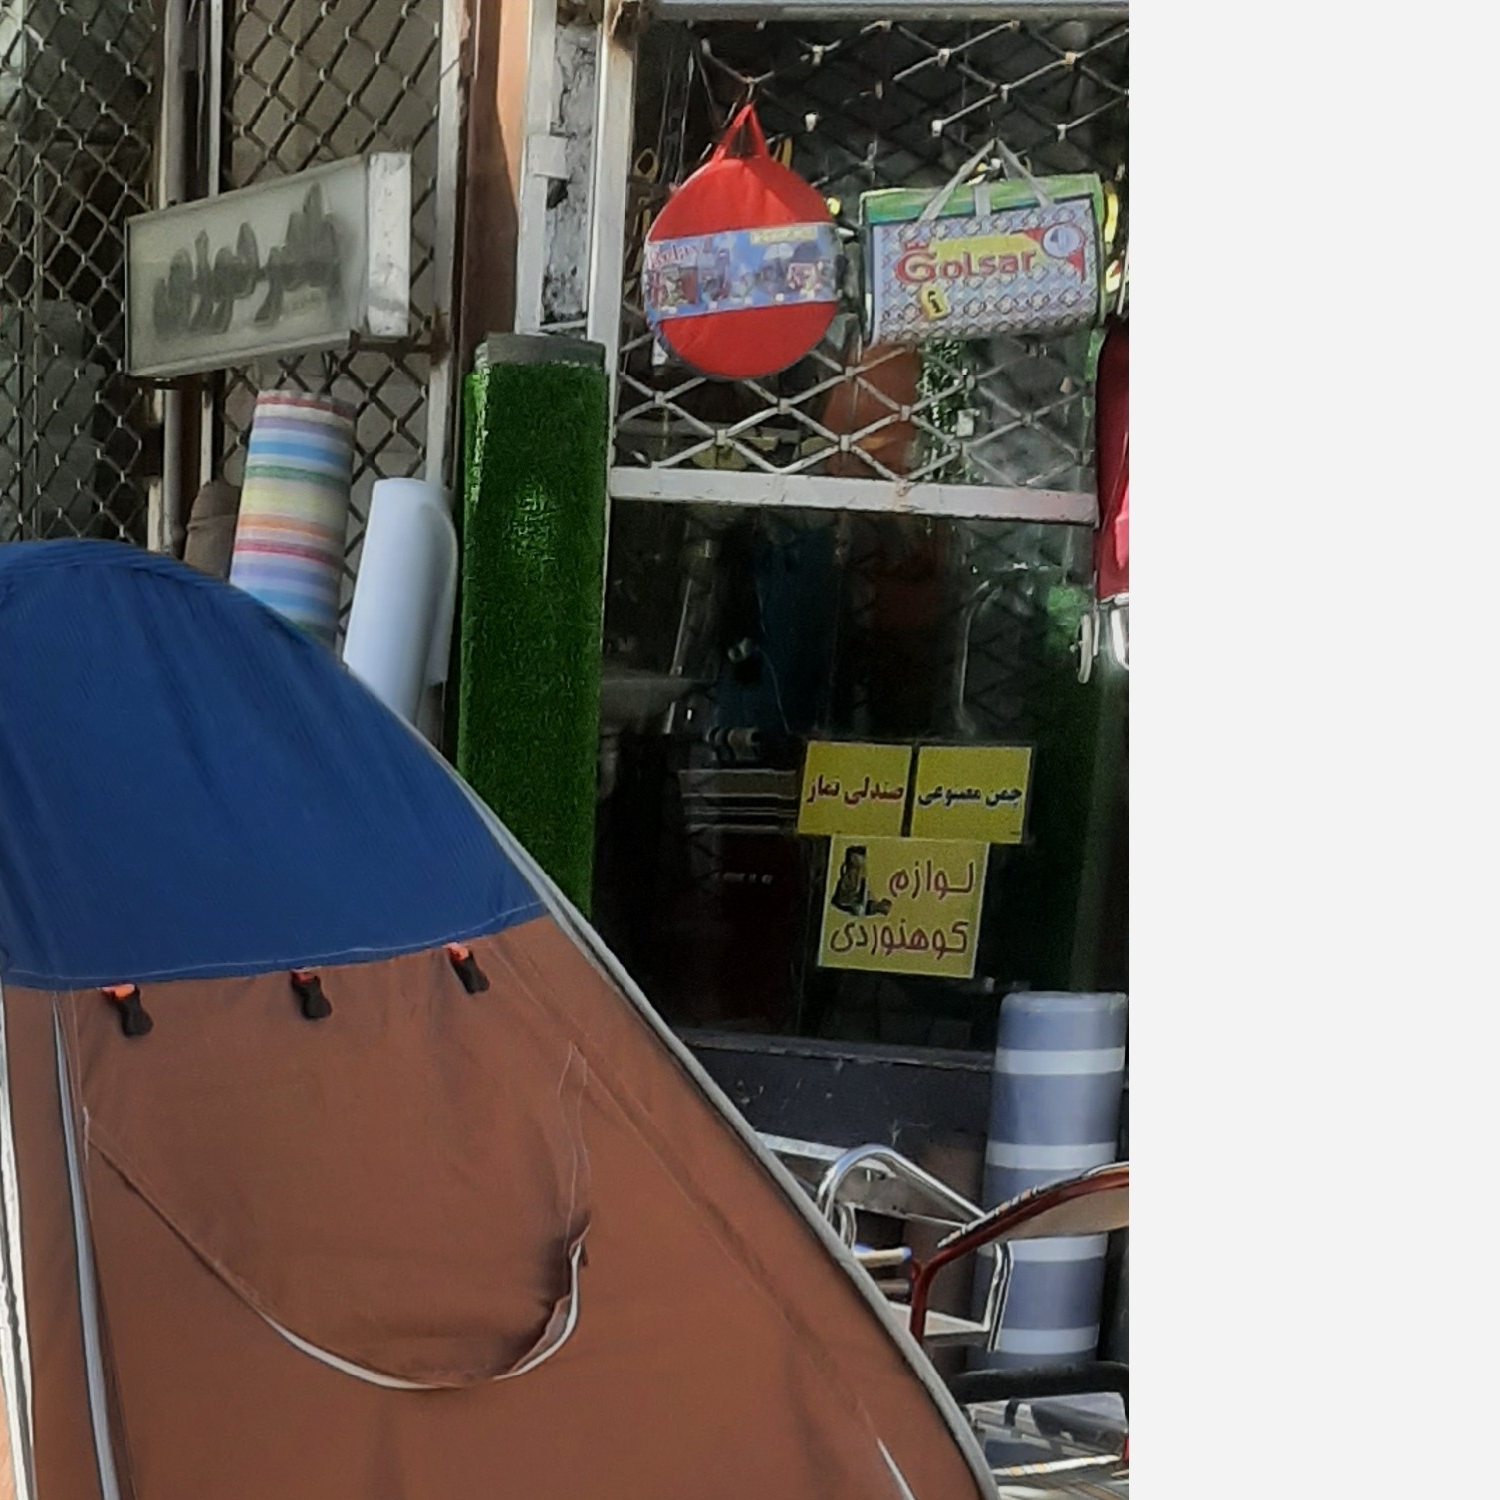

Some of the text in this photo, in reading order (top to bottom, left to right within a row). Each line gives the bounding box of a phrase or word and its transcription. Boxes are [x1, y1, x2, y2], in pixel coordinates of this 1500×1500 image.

[895, 245, 1037, 284] Golsar
[844, 776, 904, 806] صندلی
[889, 860, 975, 899] لوازم
[830, 918, 969, 960] کوهنوردی
